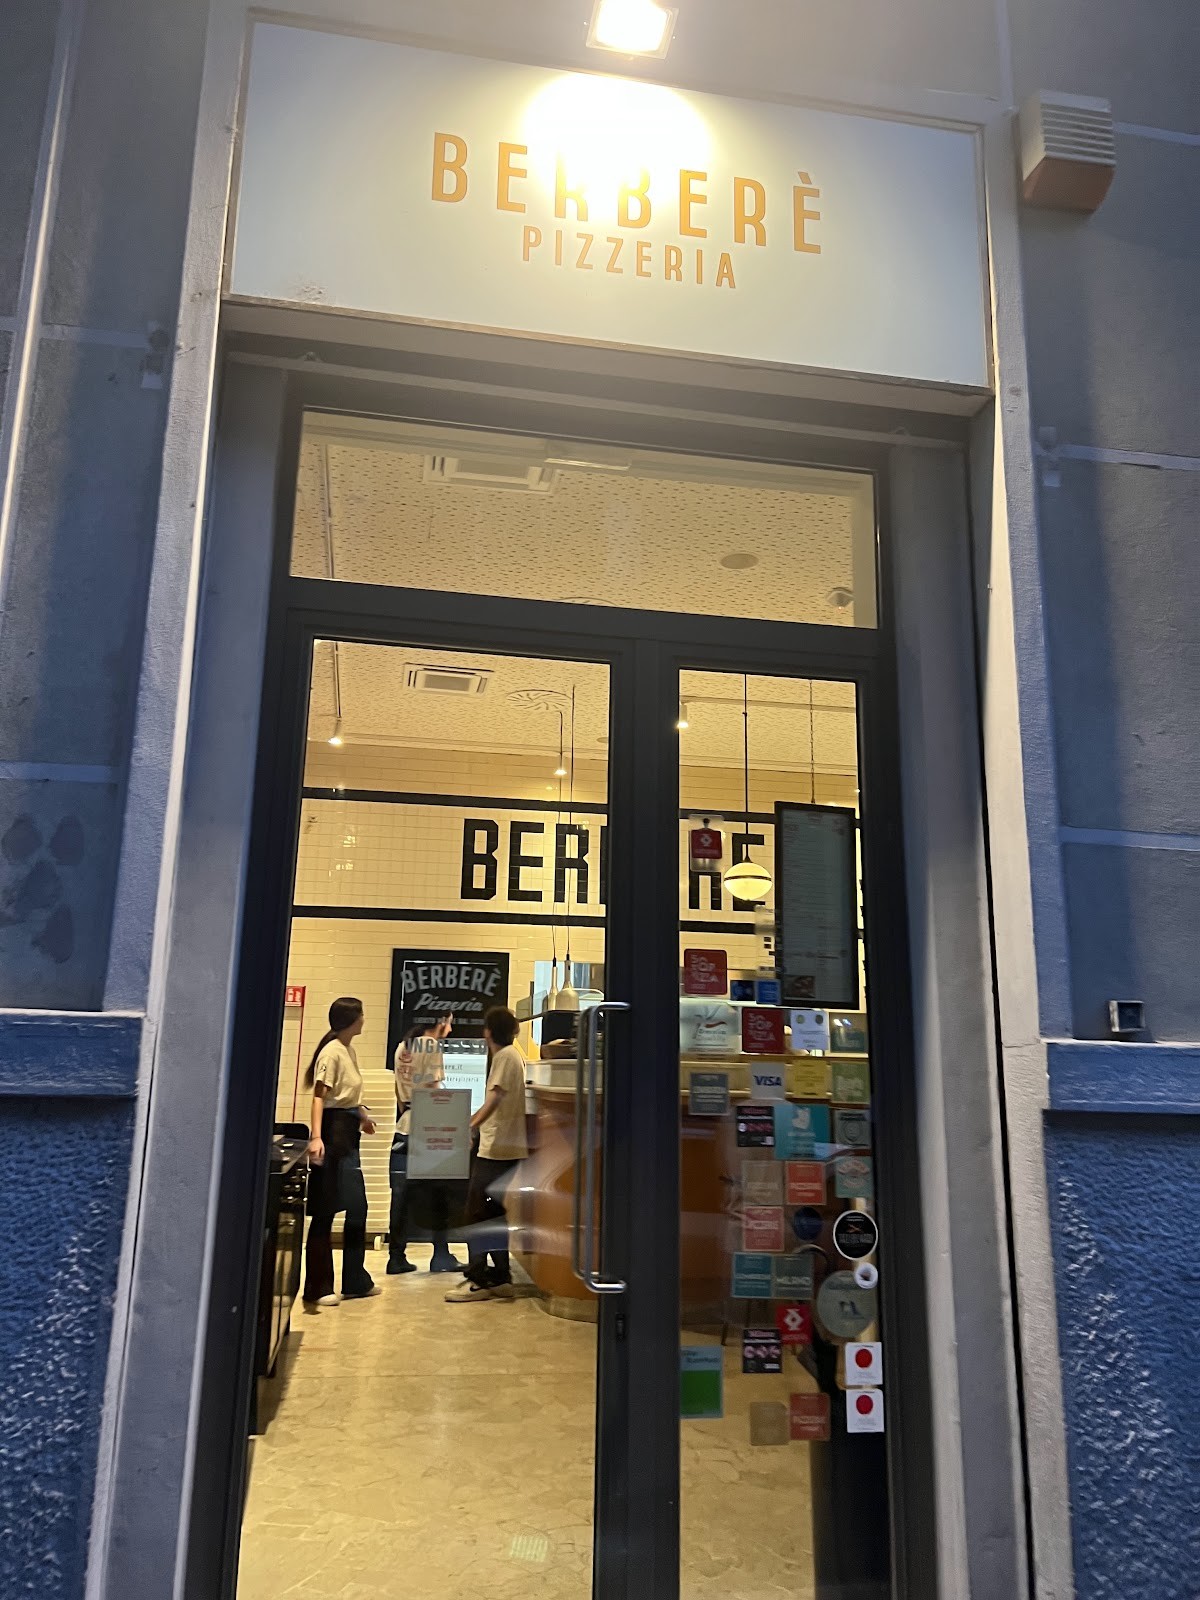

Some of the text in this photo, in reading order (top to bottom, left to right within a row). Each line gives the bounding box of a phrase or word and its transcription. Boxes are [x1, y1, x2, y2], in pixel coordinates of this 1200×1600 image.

[522, 225, 736, 289] PIZZERIA
[401, 965, 502, 997] BERBERÈ
[413, 993, 484, 1012] Pizzeria
[753, 1075, 783, 1087] VISA
